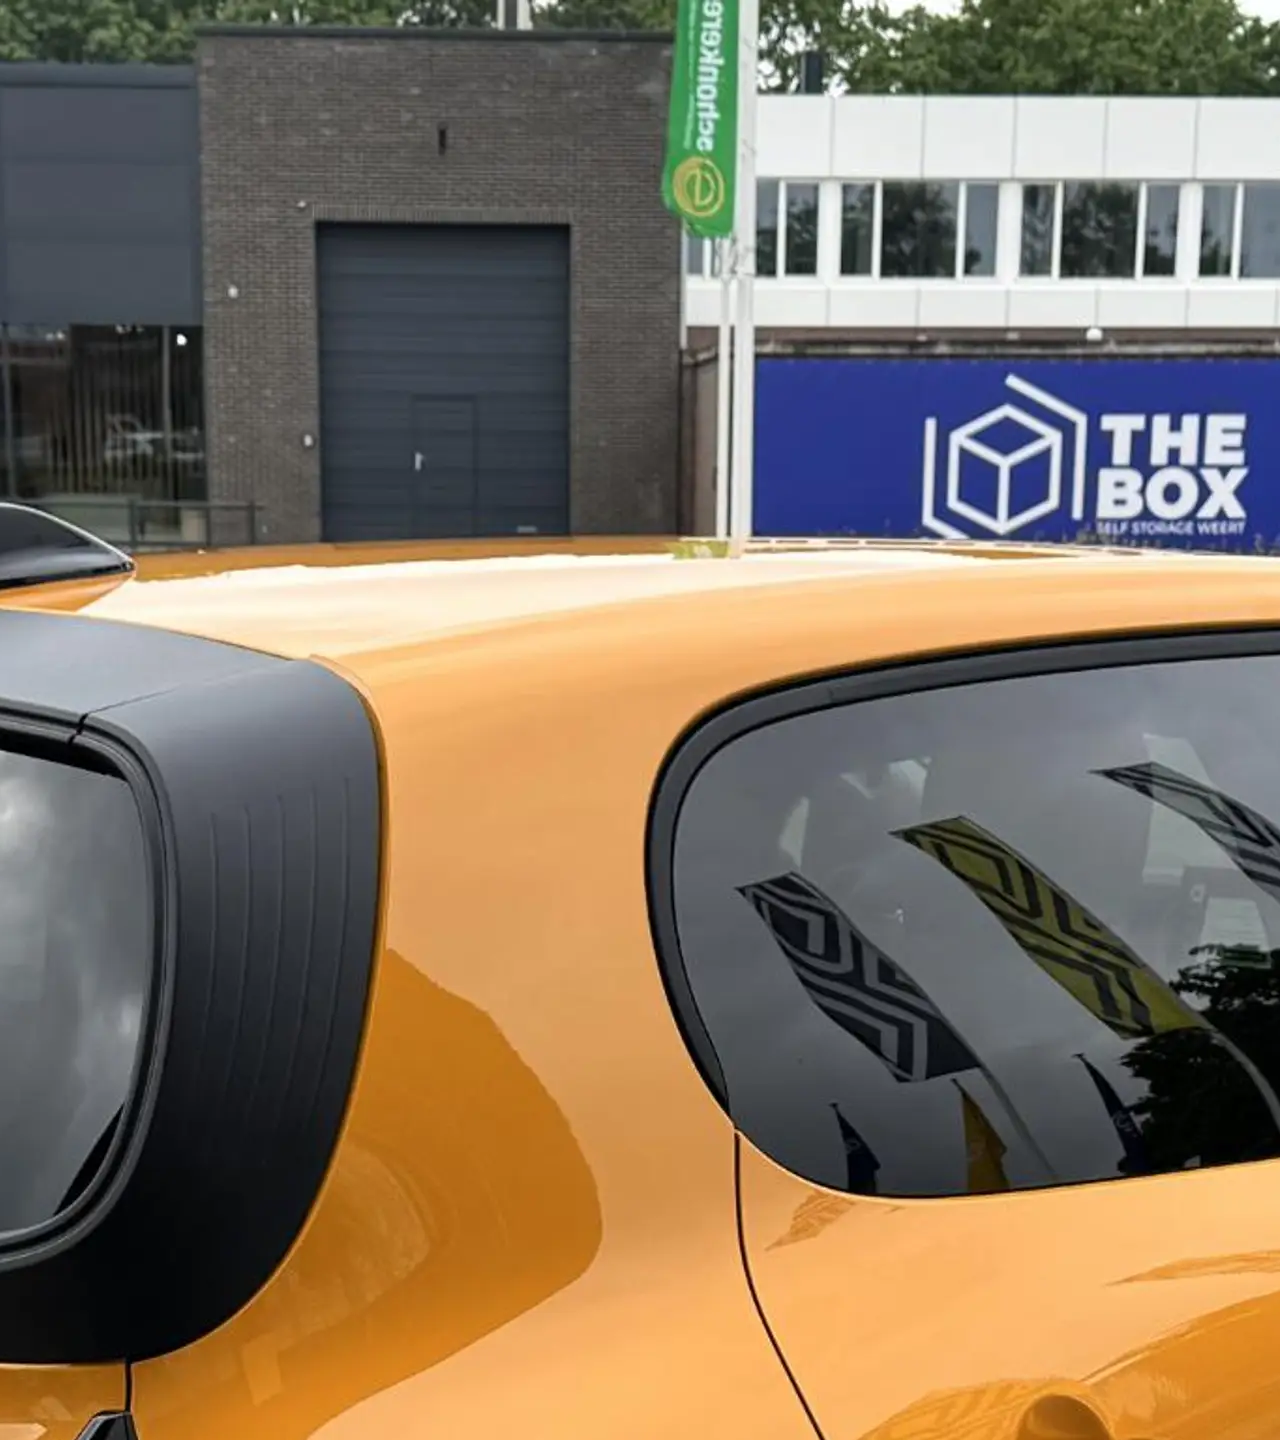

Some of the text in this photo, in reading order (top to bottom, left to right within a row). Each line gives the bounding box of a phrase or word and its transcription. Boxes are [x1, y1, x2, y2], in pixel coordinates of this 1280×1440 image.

[1100, 413, 1247, 466] THE
[1096, 466, 1249, 520] BOX
[1096, 520, 1247, 537] SELF STORAGE WEERT
